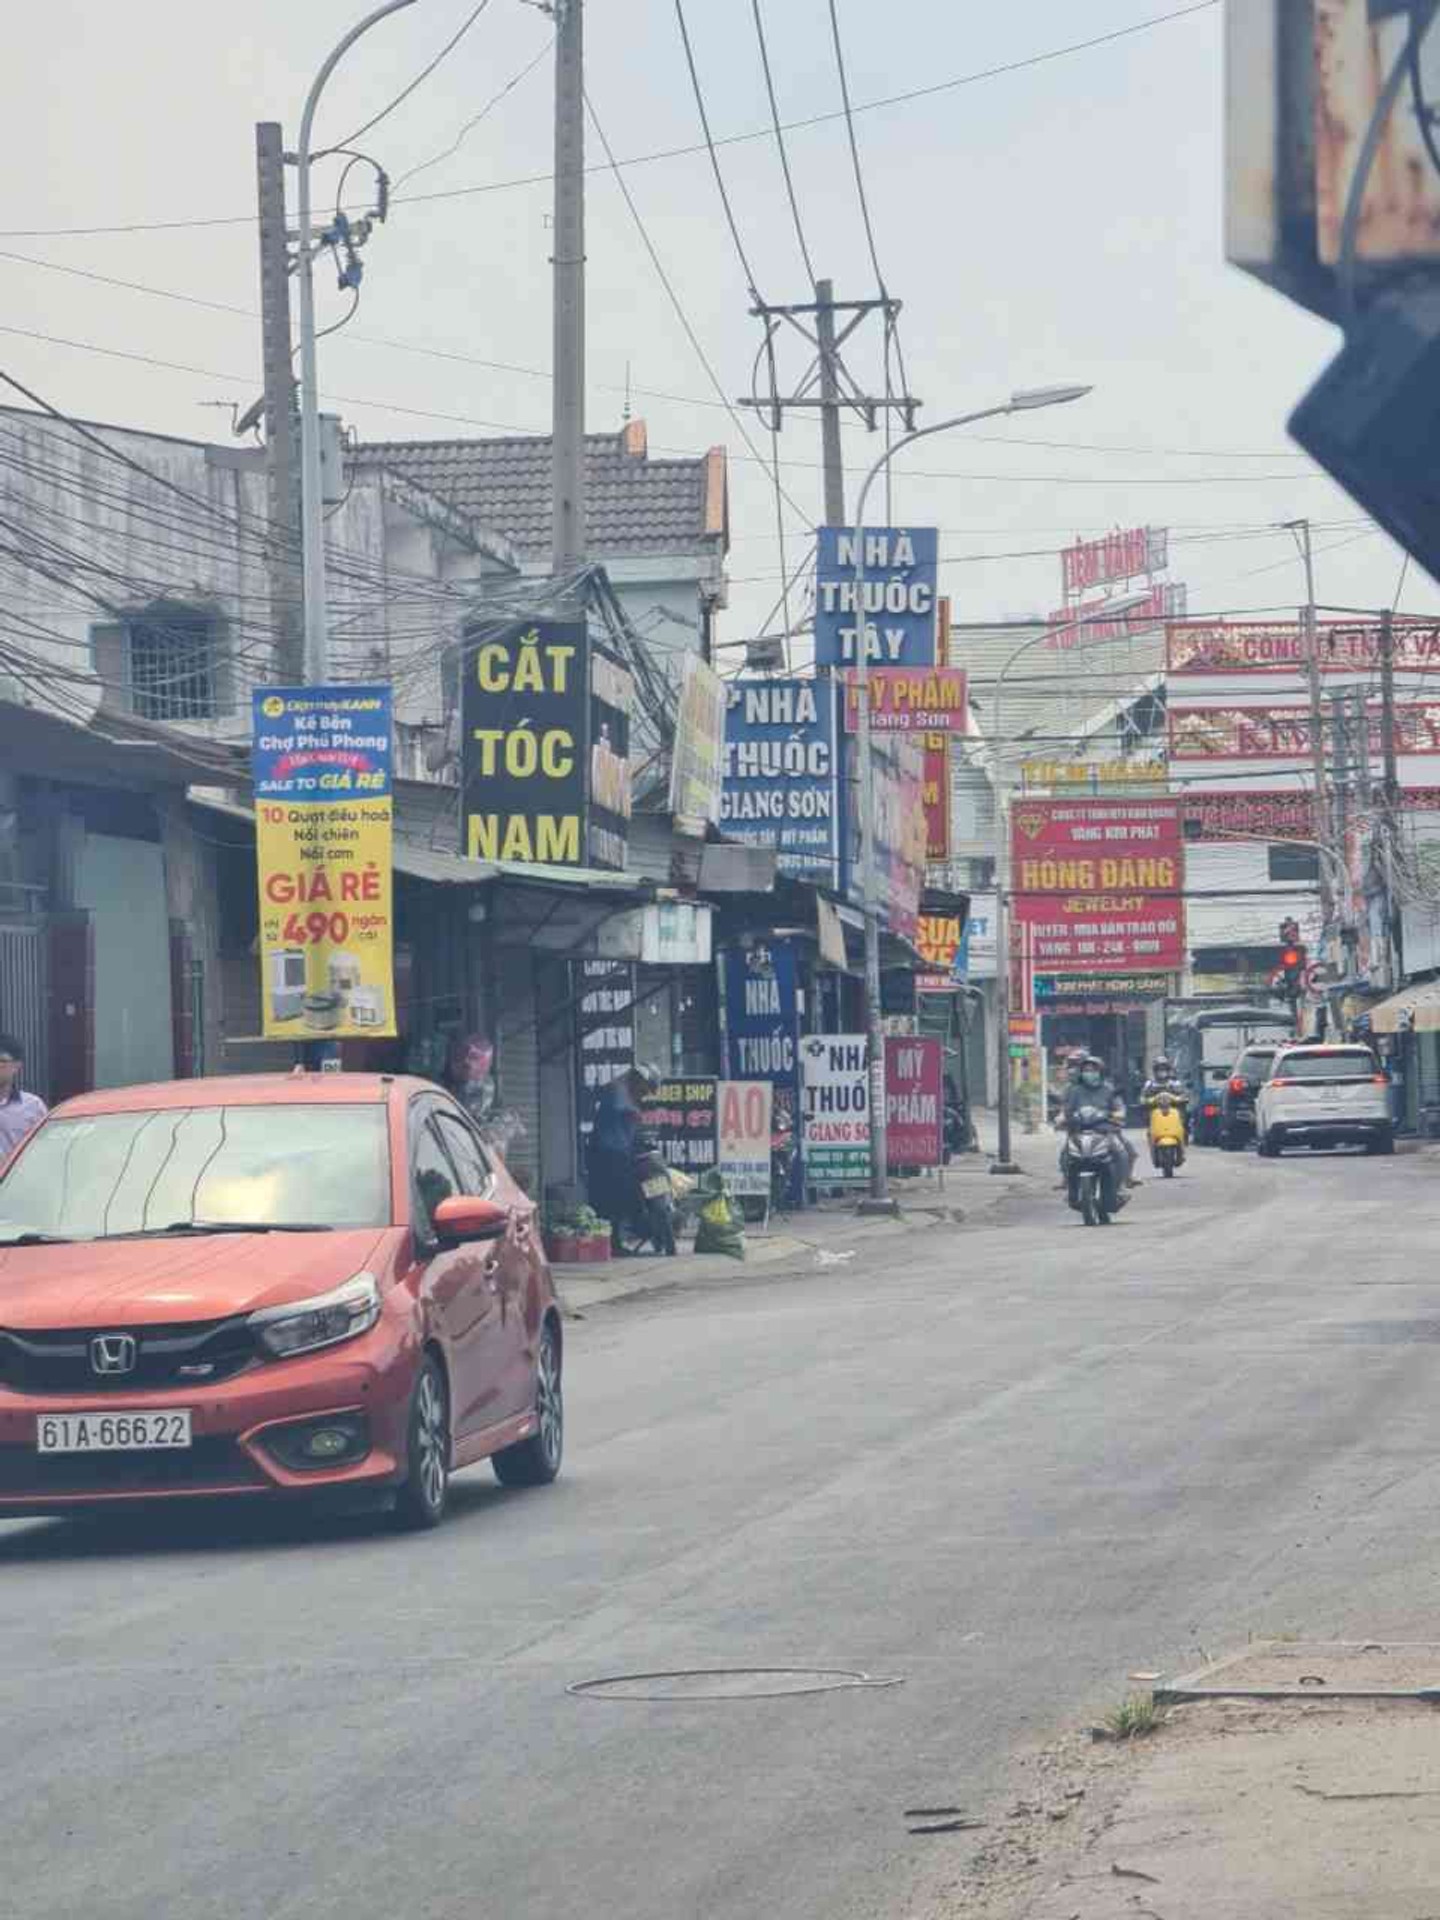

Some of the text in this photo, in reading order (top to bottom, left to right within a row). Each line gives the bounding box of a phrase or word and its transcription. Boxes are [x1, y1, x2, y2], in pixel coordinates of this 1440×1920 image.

[837, 530, 916, 567] NHÀ
[820, 570, 931, 613] THUỐC
[478, 628, 576, 692] CẮT
[838, 622, 905, 660] TÂY
[745, 681, 818, 723] NHÀ
[893, 671, 961, 710] PHẨM
[869, 710, 910, 729] iang
[331, 735, 388, 752] Phong
[474, 718, 574, 778] TÓC
[724, 729, 829, 778] THUỐC
[297, 778, 317, 791] TO
[319, 769, 352, 790] GIÁ
[356, 768, 385, 789] RẺ
[263, 806, 284, 824] 10
[720, 786, 831, 819] GIANG SƠN
[468, 814, 579, 863] NAM
[266, 861, 381, 903] GIÁ RẺ
[283, 911, 350, 945] 490
[738, 1022, 794, 1073] THUỐC
[897, 1042, 925, 1079] MỸ
[806, 1074, 867, 1112] THUỐ
[887, 1082, 937, 1123] PHẨM
[42, 1416, 185, 1449] 61A-666.22
